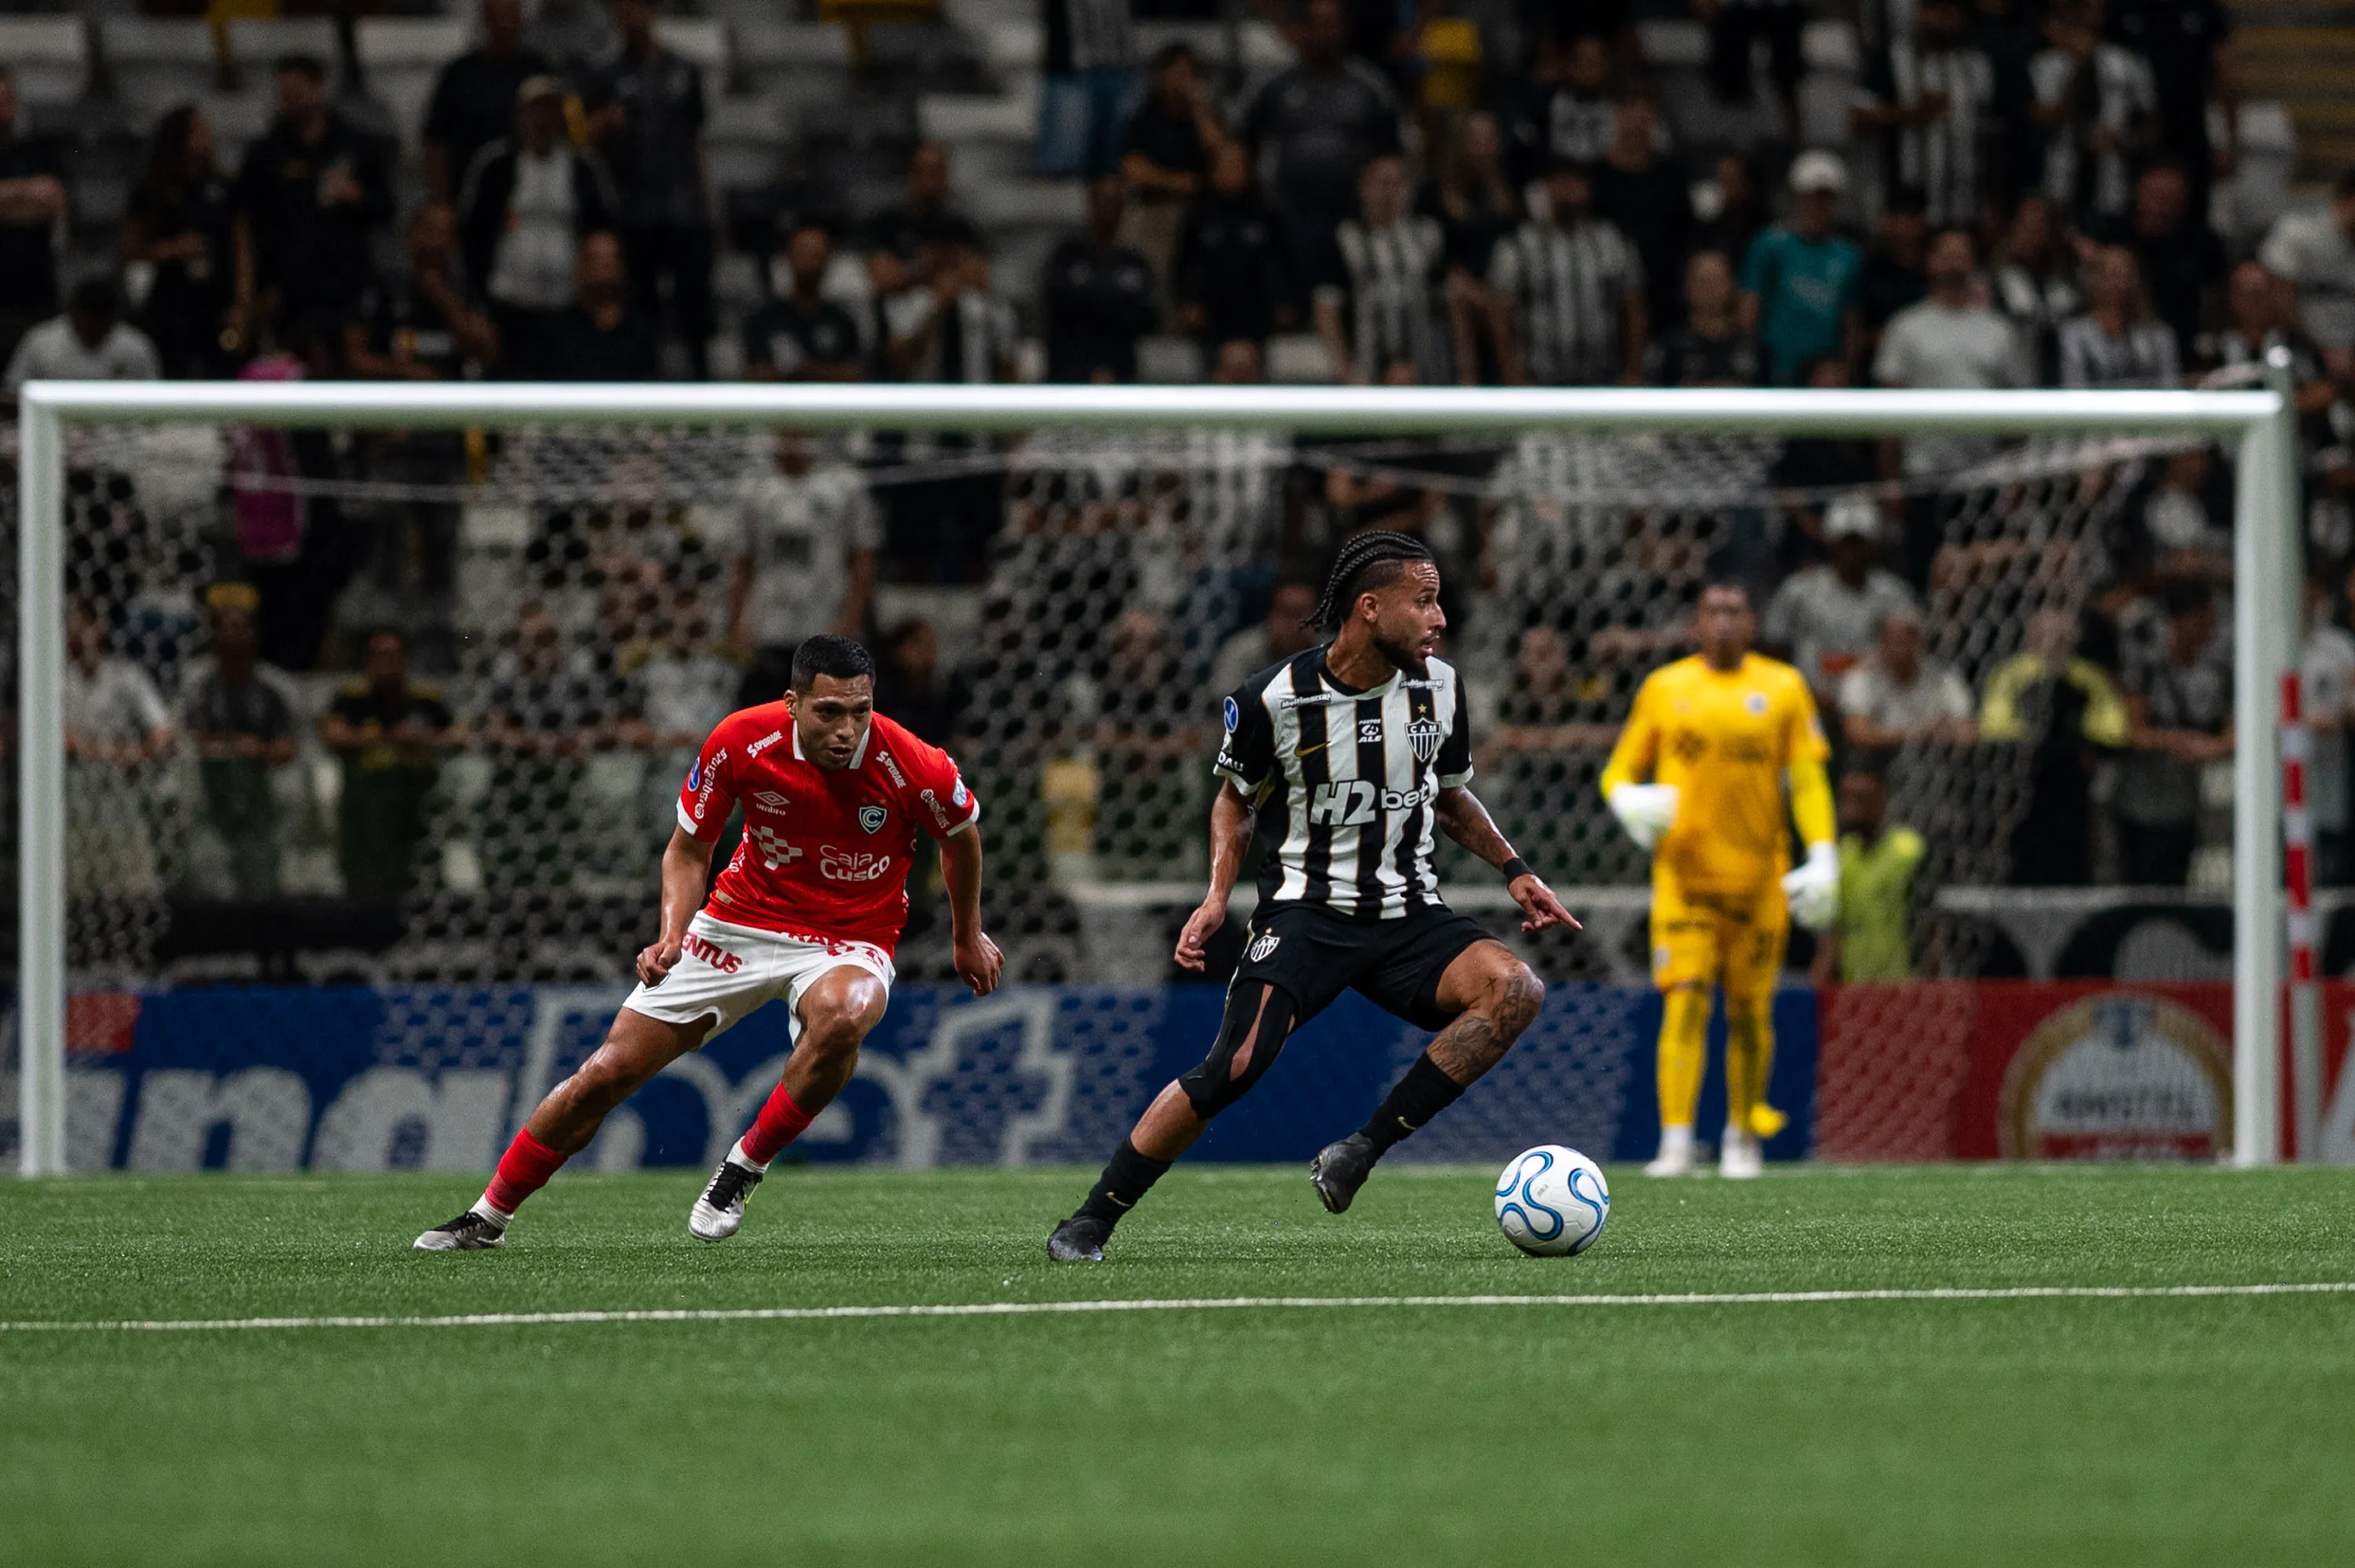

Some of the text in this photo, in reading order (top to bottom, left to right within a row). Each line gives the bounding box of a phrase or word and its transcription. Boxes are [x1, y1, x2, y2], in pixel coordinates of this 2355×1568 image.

[1410, 724, 1437, 733] CAM
[1358, 735, 1382, 743] ALE
[756, 803, 787, 816] umbro
[820, 844, 873, 870] Caja
[820, 855, 890, 881] Cusco
